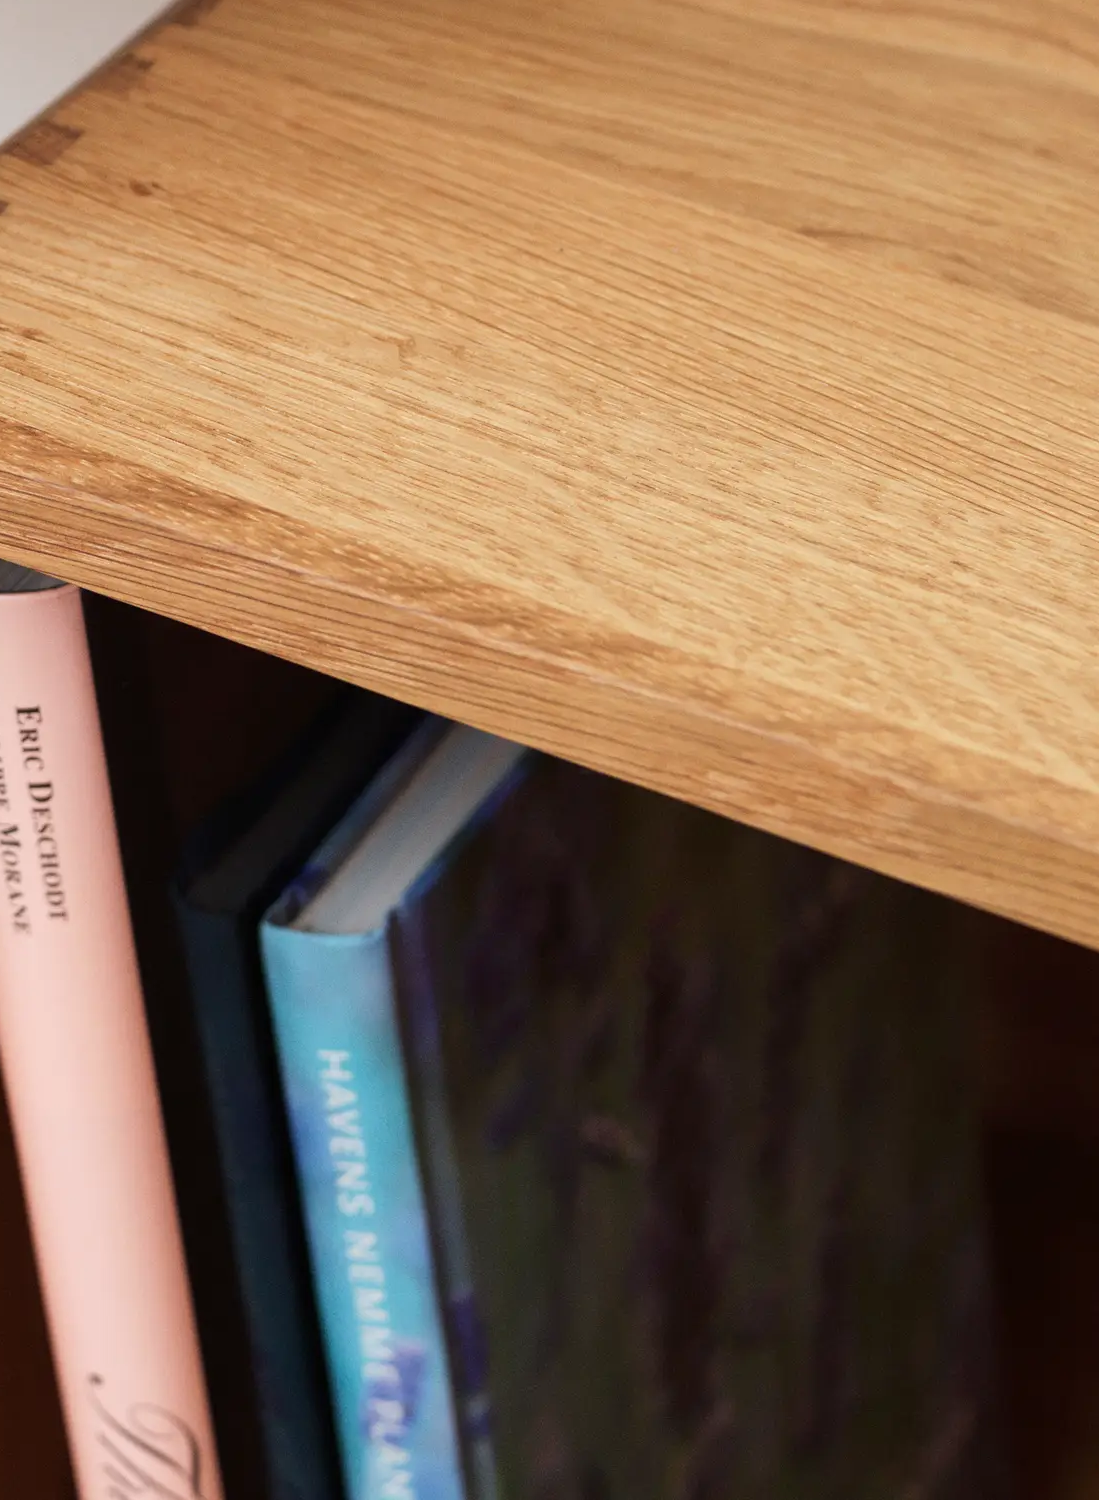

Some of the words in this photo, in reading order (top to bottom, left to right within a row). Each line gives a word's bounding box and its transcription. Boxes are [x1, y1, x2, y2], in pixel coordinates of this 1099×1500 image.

[16, 704, 45, 771] ERIC
[27, 782, 69, 922] DESCHODT
[316, 1049, 375, 1217] HAVENS
[344, 1229, 401, 1392] NEMME
